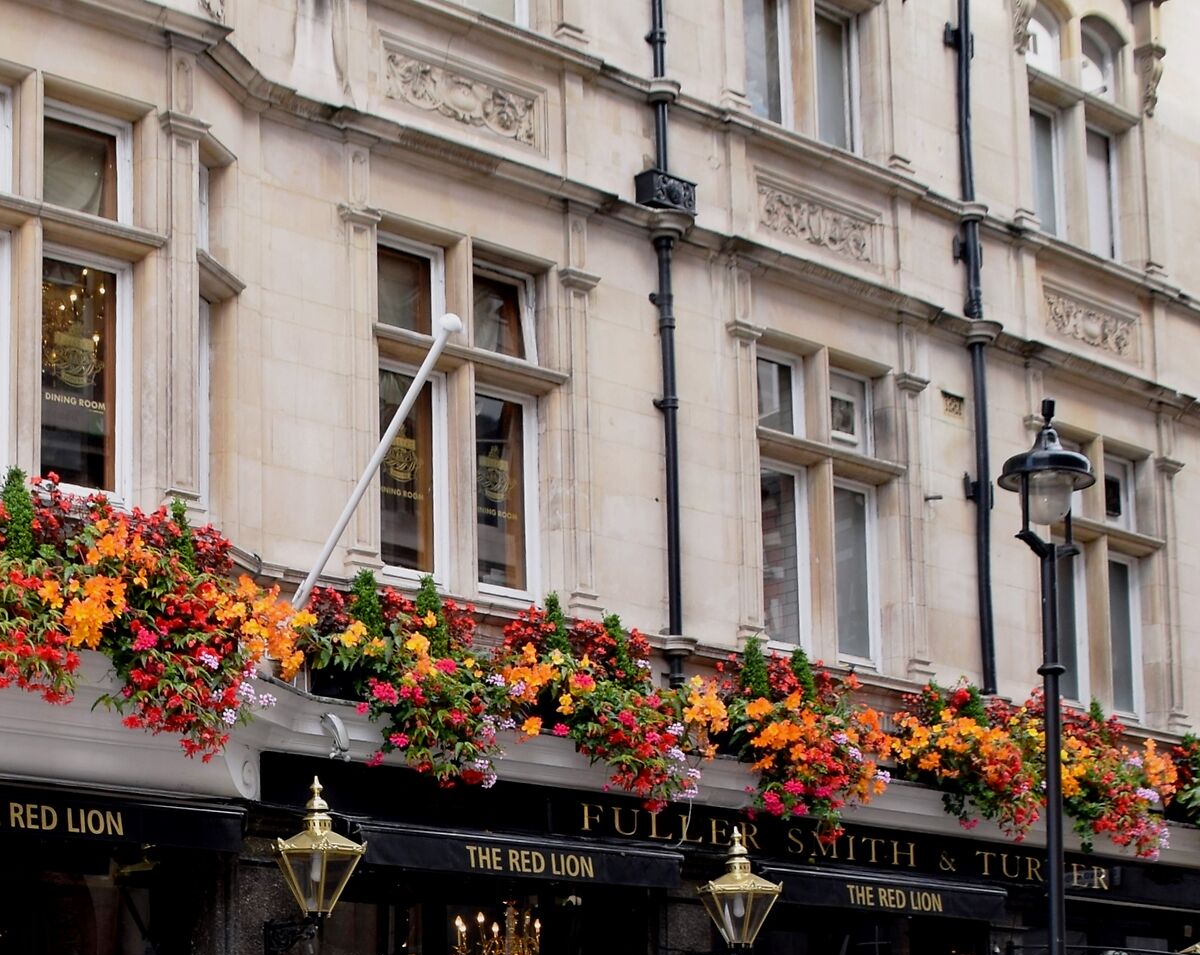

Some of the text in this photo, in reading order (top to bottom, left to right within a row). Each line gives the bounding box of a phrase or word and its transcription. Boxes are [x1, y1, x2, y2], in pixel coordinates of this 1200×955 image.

[45, 392, 106, 411] DINING ROOM
[9, 802, 58, 830] RED
[67, 808, 124, 836] LION
[466, 845, 595, 878] THE RED LION
[581, 803, 1109, 890] FULLER SMITH & TURER
[846, 884, 943, 913] THE RED LION
